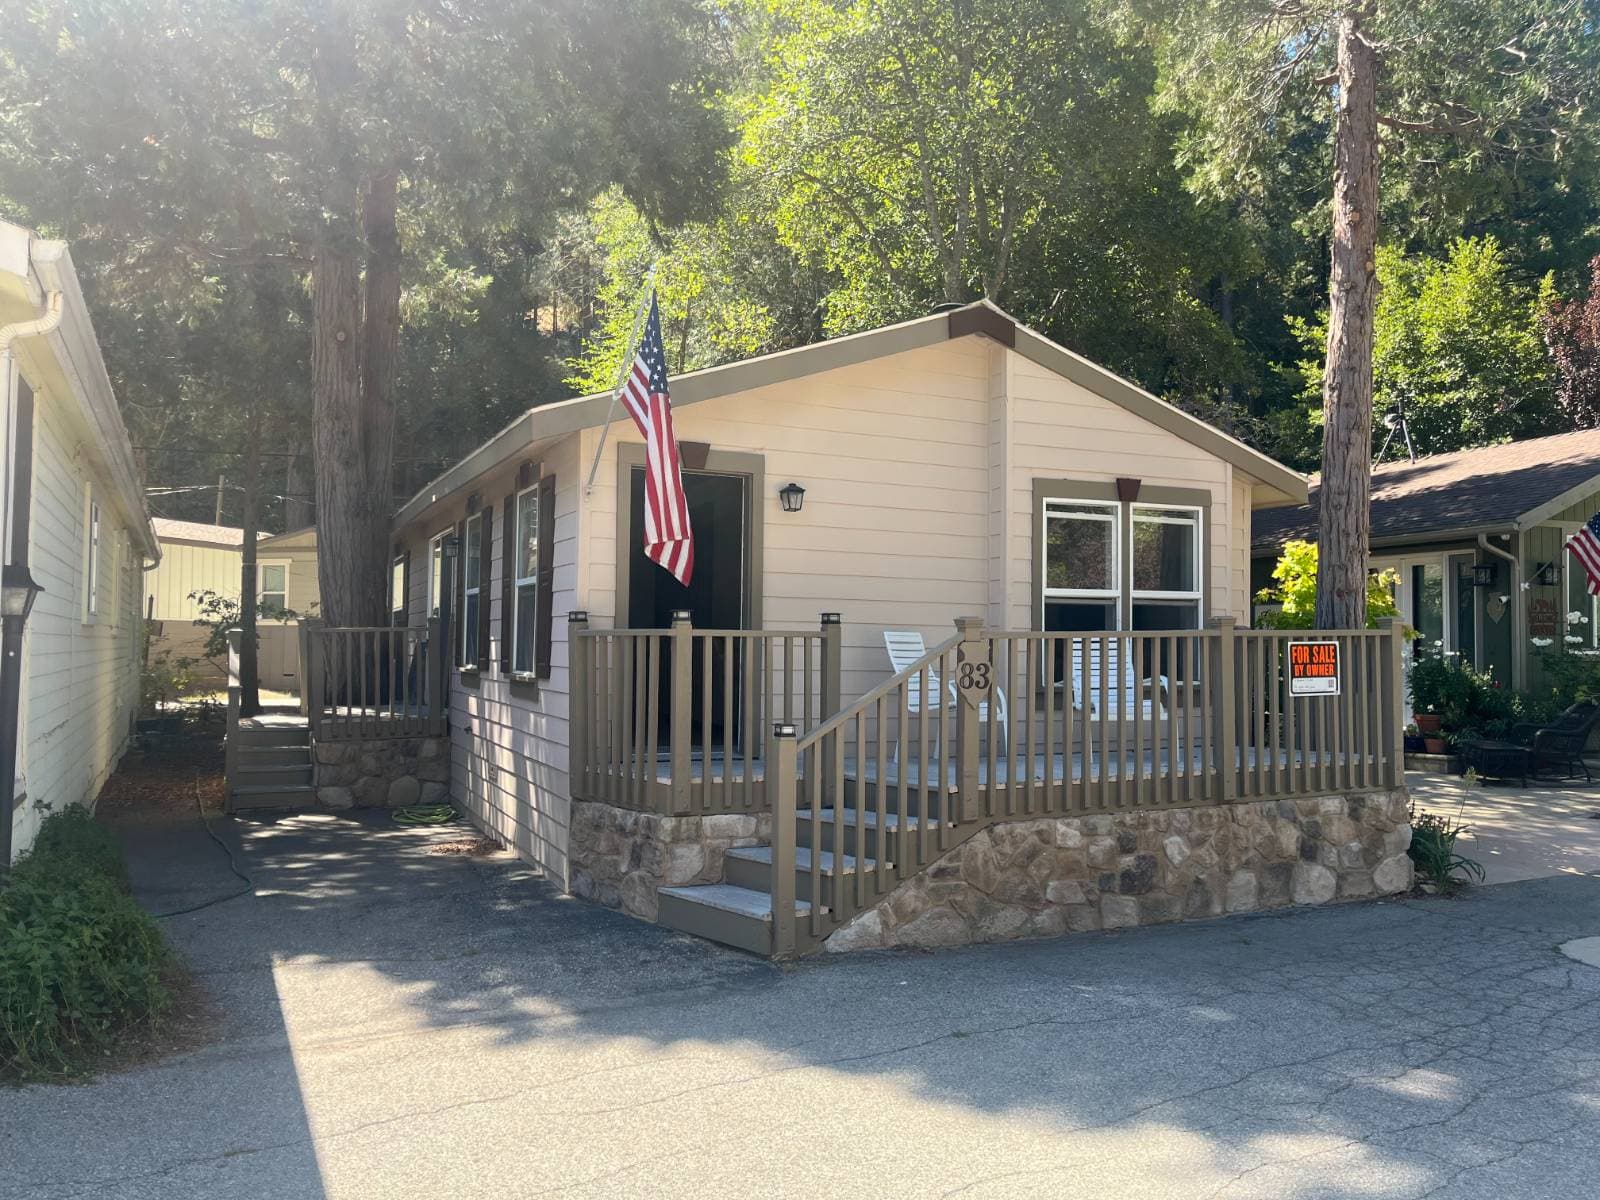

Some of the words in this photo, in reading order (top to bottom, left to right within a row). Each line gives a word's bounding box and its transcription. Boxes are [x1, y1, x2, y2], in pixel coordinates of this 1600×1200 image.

[1292, 645, 1309, 663] FOR
[1313, 645, 1335, 663] SALE
[959, 662, 990, 690] 83
[1294, 664, 1304, 677] BY
[1306, 664, 1334, 676] OWNER
